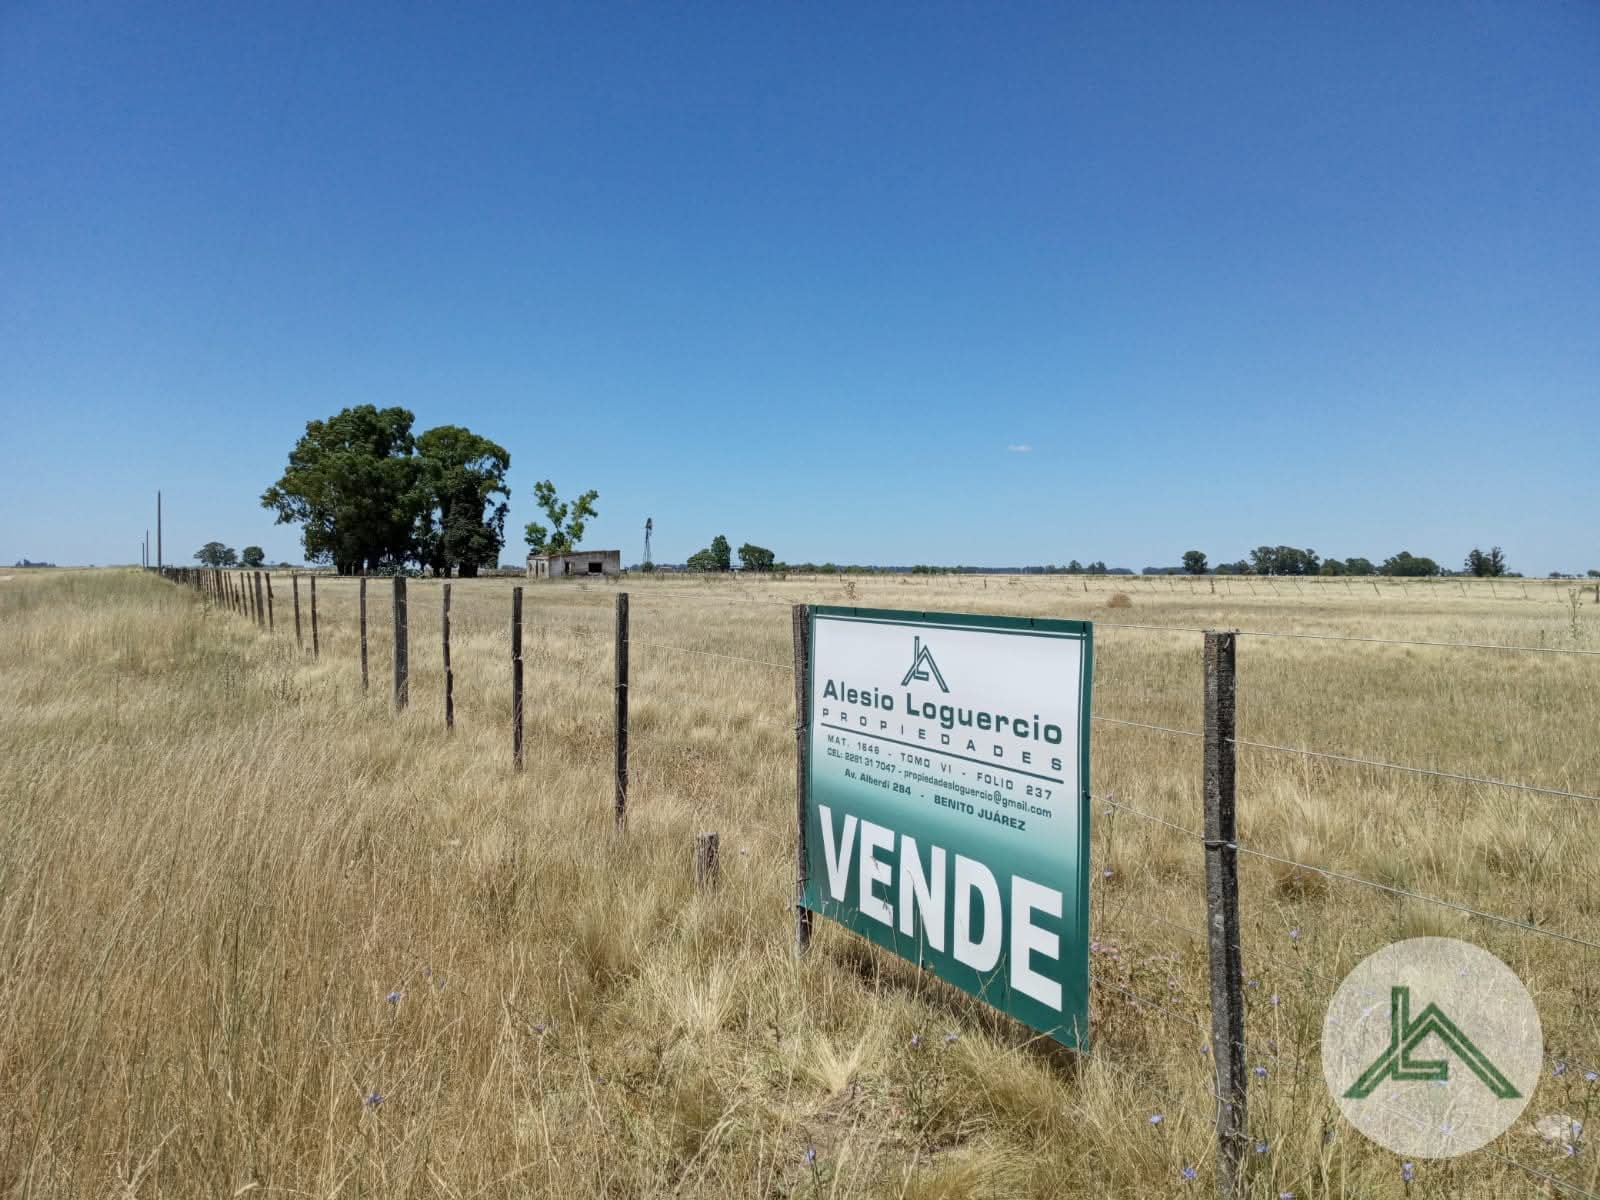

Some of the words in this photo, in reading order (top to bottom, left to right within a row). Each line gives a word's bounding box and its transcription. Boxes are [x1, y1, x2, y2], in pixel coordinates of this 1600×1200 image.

[822, 707, 1062, 771] PROPIEDADES
[823, 679, 894, 711] Alesio
[906, 692, 1062, 745] Loguercio
[826, 747, 843, 759] CEL:
[875, 760, 896, 773] 7047
[903, 770, 1052, 819] propiedadesloguercio@gmail.com
[827, 734, 850, 747] MAT.
[900, 752, 930, 768] TOMO
[940, 762, 951, 774] VI
[977, 772, 1014, 791] FOLIO
[1025, 784, 1053, 800] 237
[844, 768, 858, 780] Av.
[860, 773, 890, 789] Alberdi
[933, 795, 975, 815] BENITO
[977, 808, 1027, 832] JUÁREZ
[818, 804, 1063, 1012] VENDE
